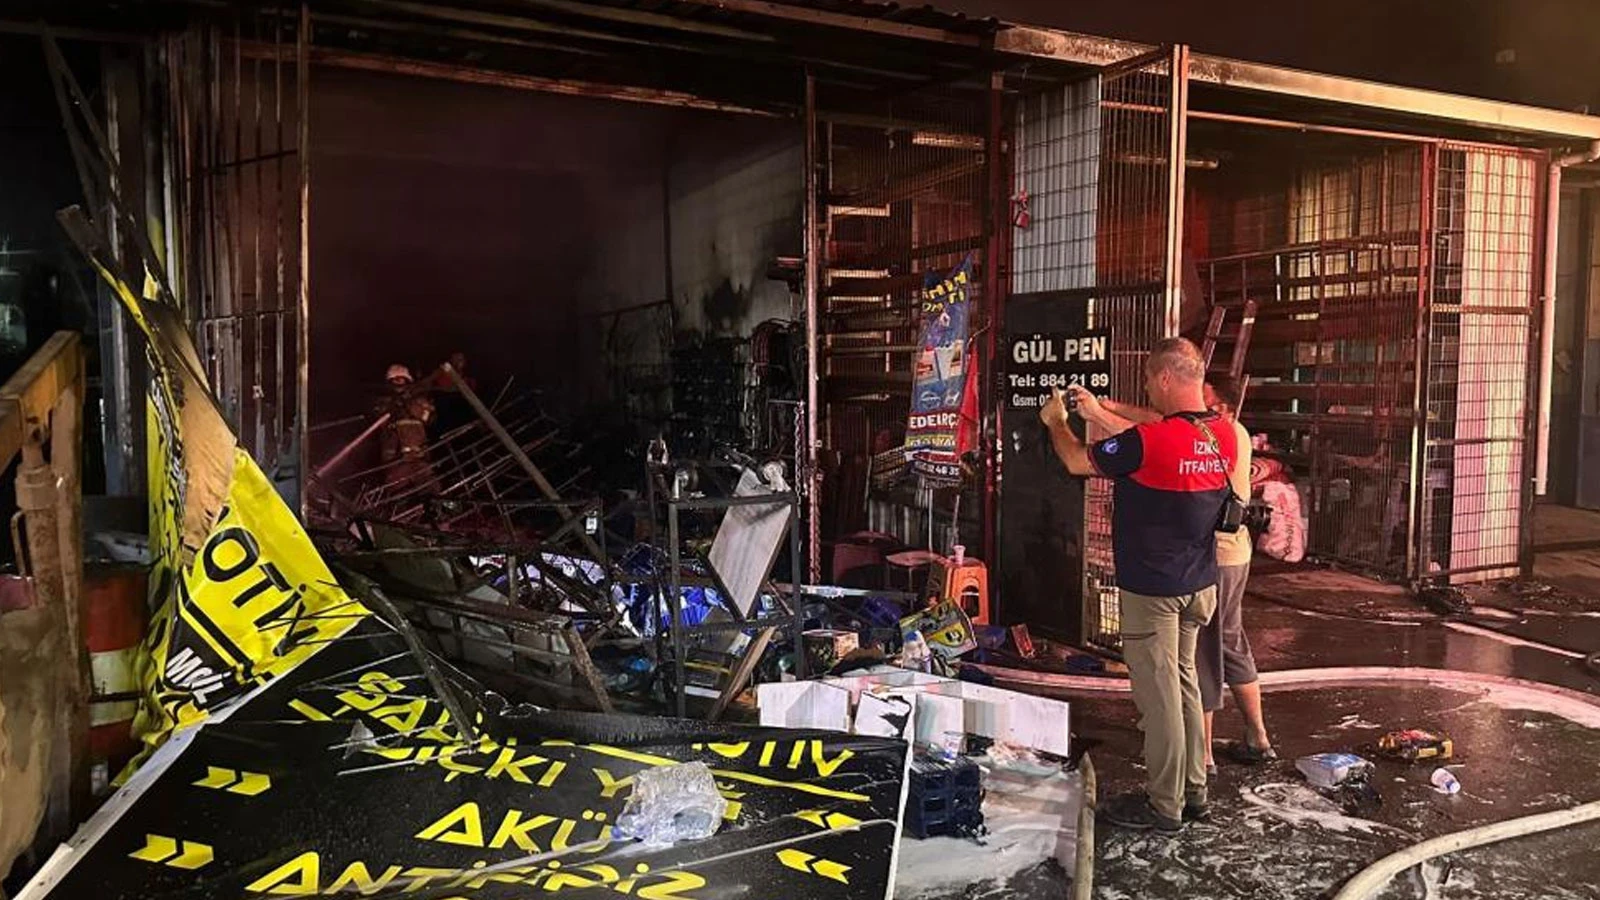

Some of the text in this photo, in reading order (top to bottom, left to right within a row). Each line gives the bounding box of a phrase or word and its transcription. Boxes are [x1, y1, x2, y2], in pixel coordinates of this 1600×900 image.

[1013, 334, 1106, 364] GÜL PEN
[1008, 373, 1109, 387] Tel: 884 21 89
[1012, 393, 1037, 407] Gsm:
[414, 801, 612, 853] AKÜ
